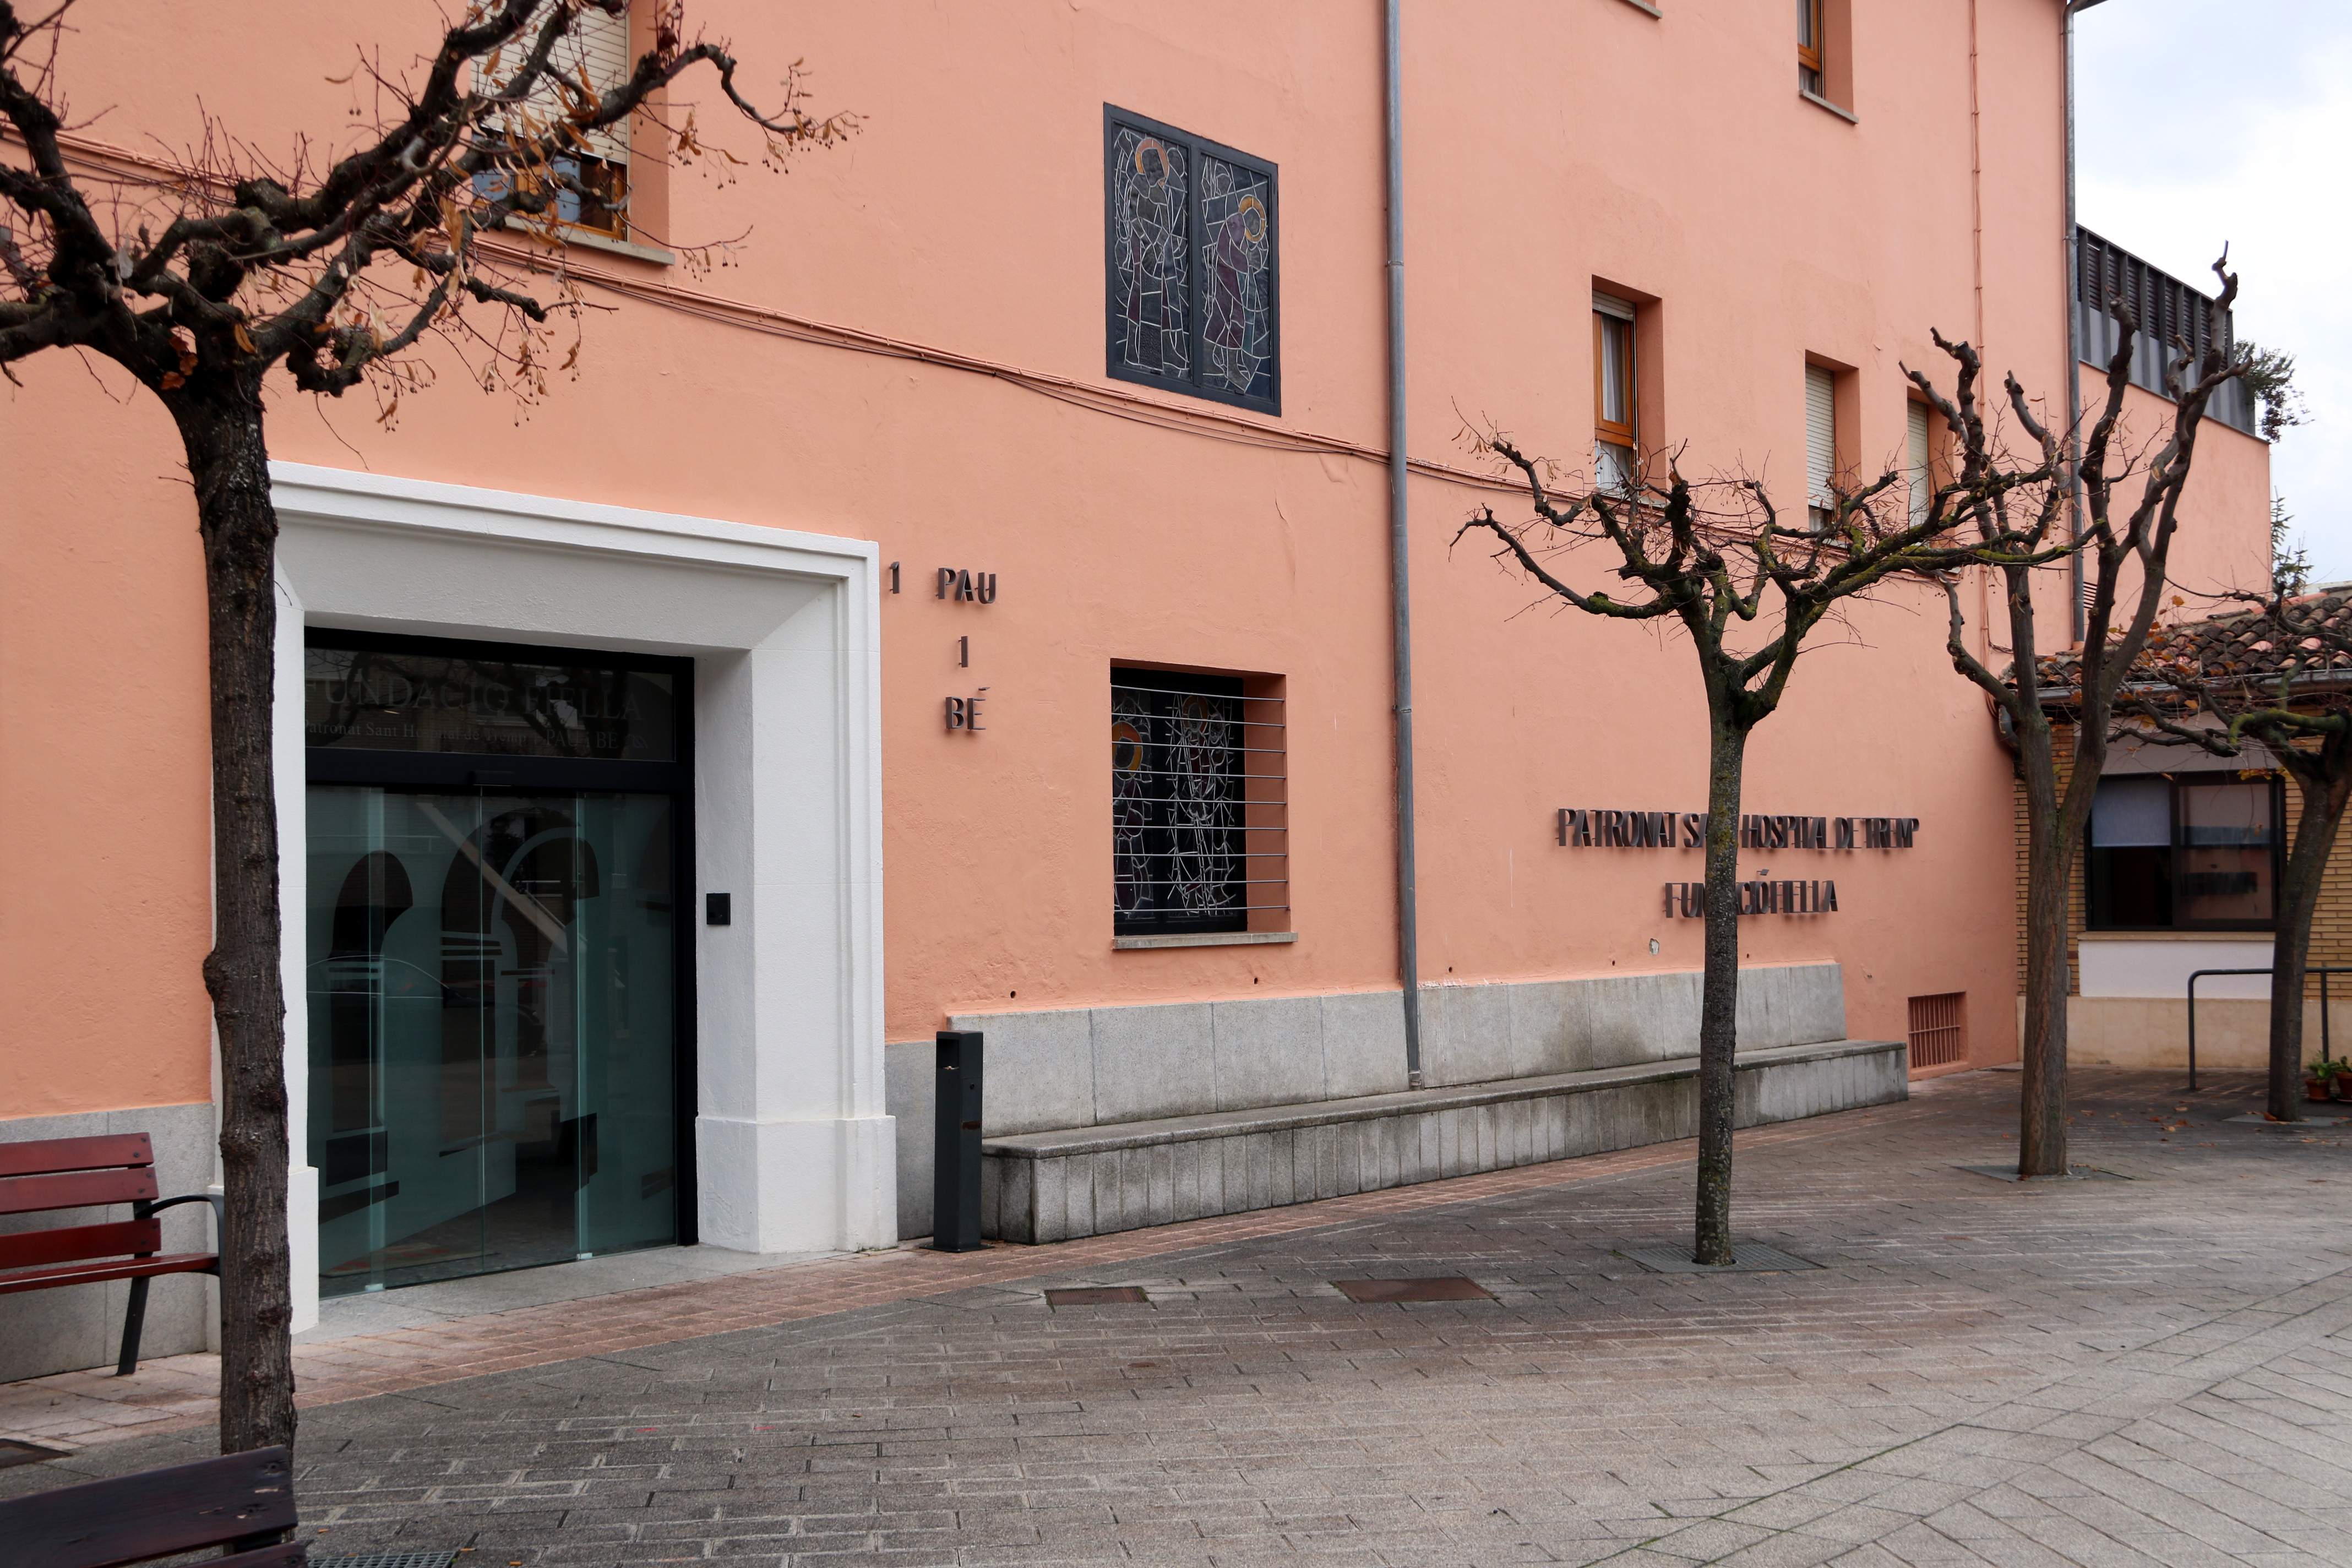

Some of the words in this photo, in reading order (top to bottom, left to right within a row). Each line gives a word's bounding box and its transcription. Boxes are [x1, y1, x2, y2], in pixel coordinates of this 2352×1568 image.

[937, 567, 997, 605] PAU
[945, 687, 991, 731] BÉ
[366, 722, 397, 737] Sant
[1558, 808, 1681, 847] PATRONAT
[1741, 814, 1835, 848] HOSPITAL
[1836, 817, 1862, 848] DE
[1860, 817, 1920, 848] TREMP
